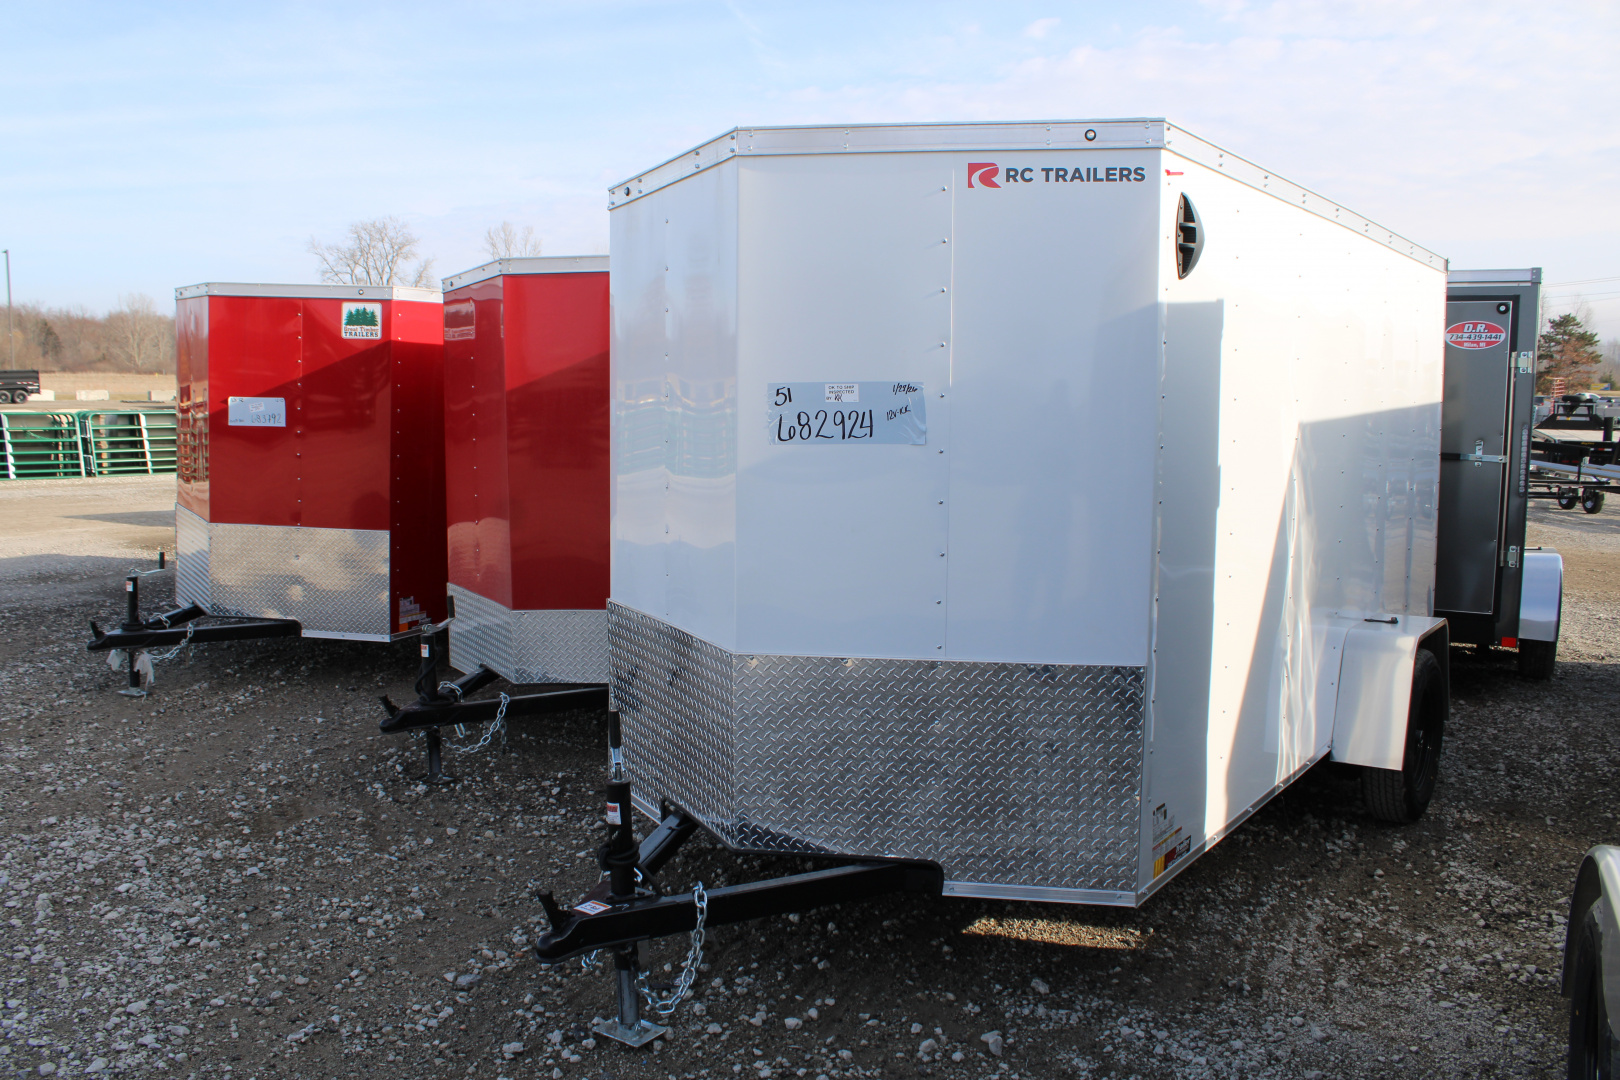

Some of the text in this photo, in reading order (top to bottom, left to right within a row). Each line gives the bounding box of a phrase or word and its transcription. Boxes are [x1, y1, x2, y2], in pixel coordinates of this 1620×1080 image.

[1005, 167, 1034, 183] RC
[1041, 167, 1146, 183] TRAILERS
[1463, 323, 1489, 333] D.R.
[1450, 333, 1502, 341] 734-439-1441
[774, 386, 793, 406] 51
[777, 409, 873, 441] 682924
